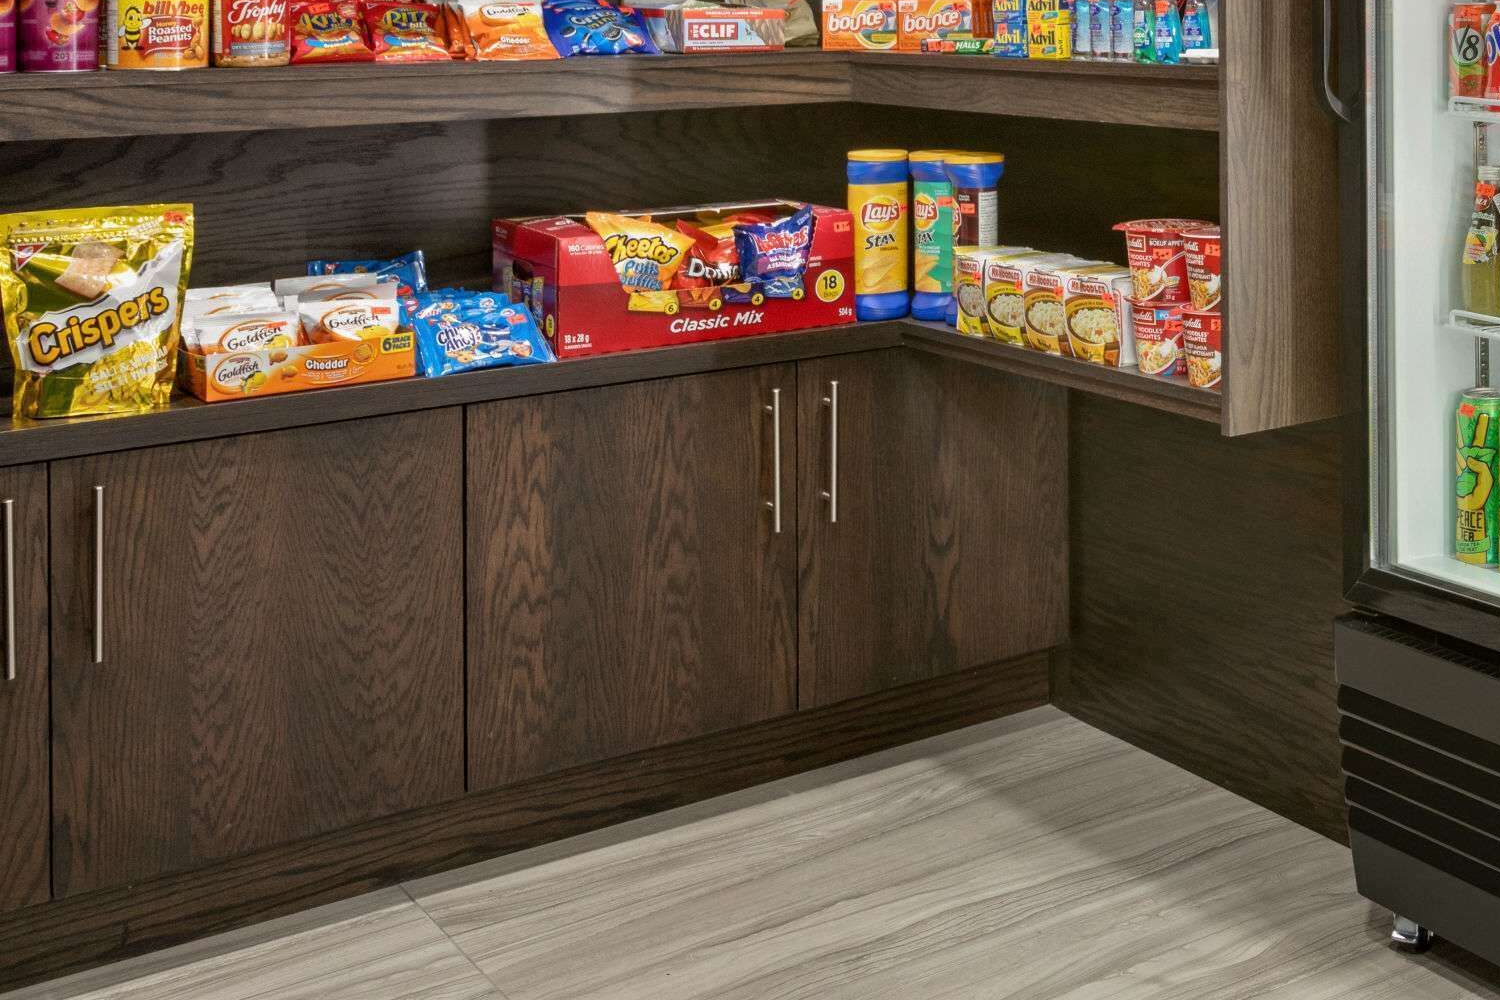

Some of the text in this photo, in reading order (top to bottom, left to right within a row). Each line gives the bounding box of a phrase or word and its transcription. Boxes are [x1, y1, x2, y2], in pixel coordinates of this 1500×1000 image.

[148, 25, 192, 34] Roasted
[828, 10, 885, 33] bounce
[903, 10, 961, 33] bounce
[149, 33, 192, 43] Peanuts
[699, 24, 736, 38] CLIF
[994, 29, 1019, 44] Advil
[1029, 30, 1056, 46] Advil
[956, 41, 981, 50] HALLS
[1453, 24, 1480, 61] V8
[863, 200, 899, 222] Lay's
[604, 235, 678, 263] Cheetos
[822, 275, 836, 290] 18
[29, 286, 170, 367] Crispers
[329, 314, 381, 330] Goldfish
[670, 310, 765, 334] Classic Mix
[227, 326, 283, 349] Goldfish
[382, 338, 391, 351] 6
[218, 361, 260, 383] Goldfish
[305, 357, 349, 371] Cheddar
